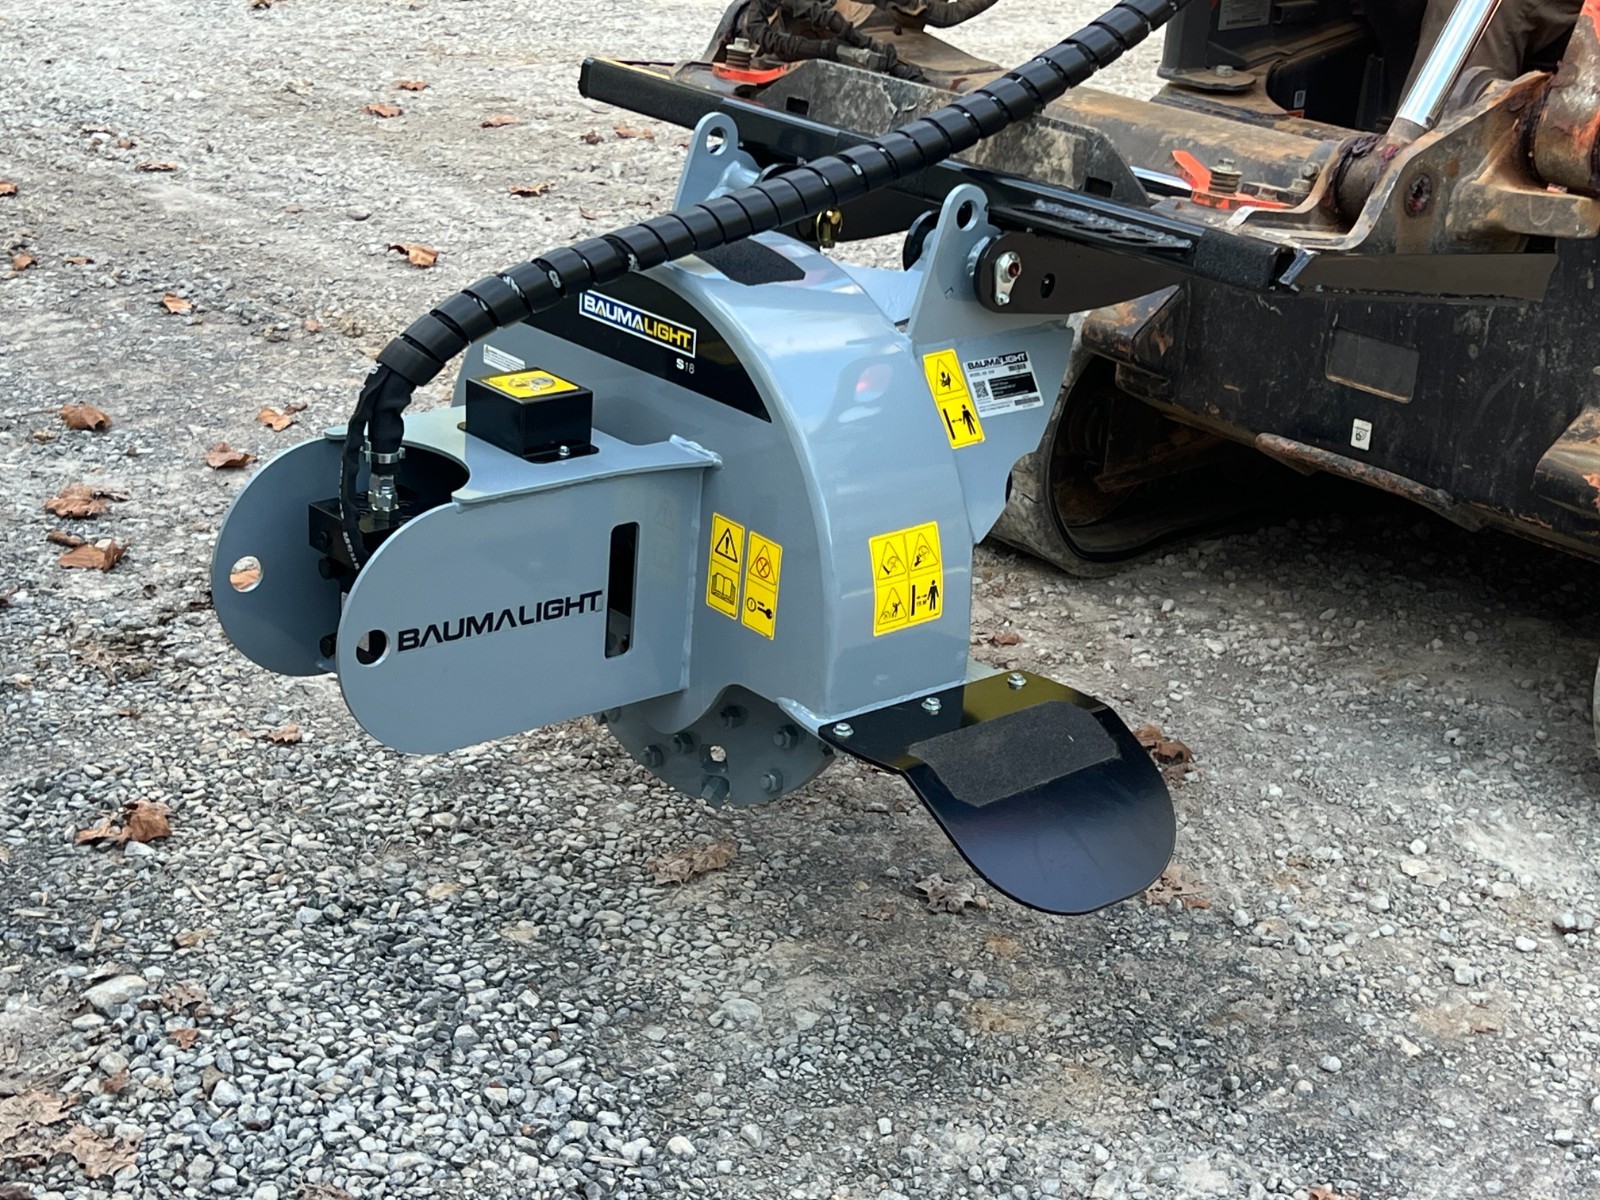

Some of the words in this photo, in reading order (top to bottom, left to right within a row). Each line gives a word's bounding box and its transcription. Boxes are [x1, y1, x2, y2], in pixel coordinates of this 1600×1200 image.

[584, 294, 691, 349] BAUMALIGHT
[676, 358, 695, 374] S18
[967, 353, 1026, 370] BAUMALIGHT
[398, 590, 603, 652] BAUMALIGHT
